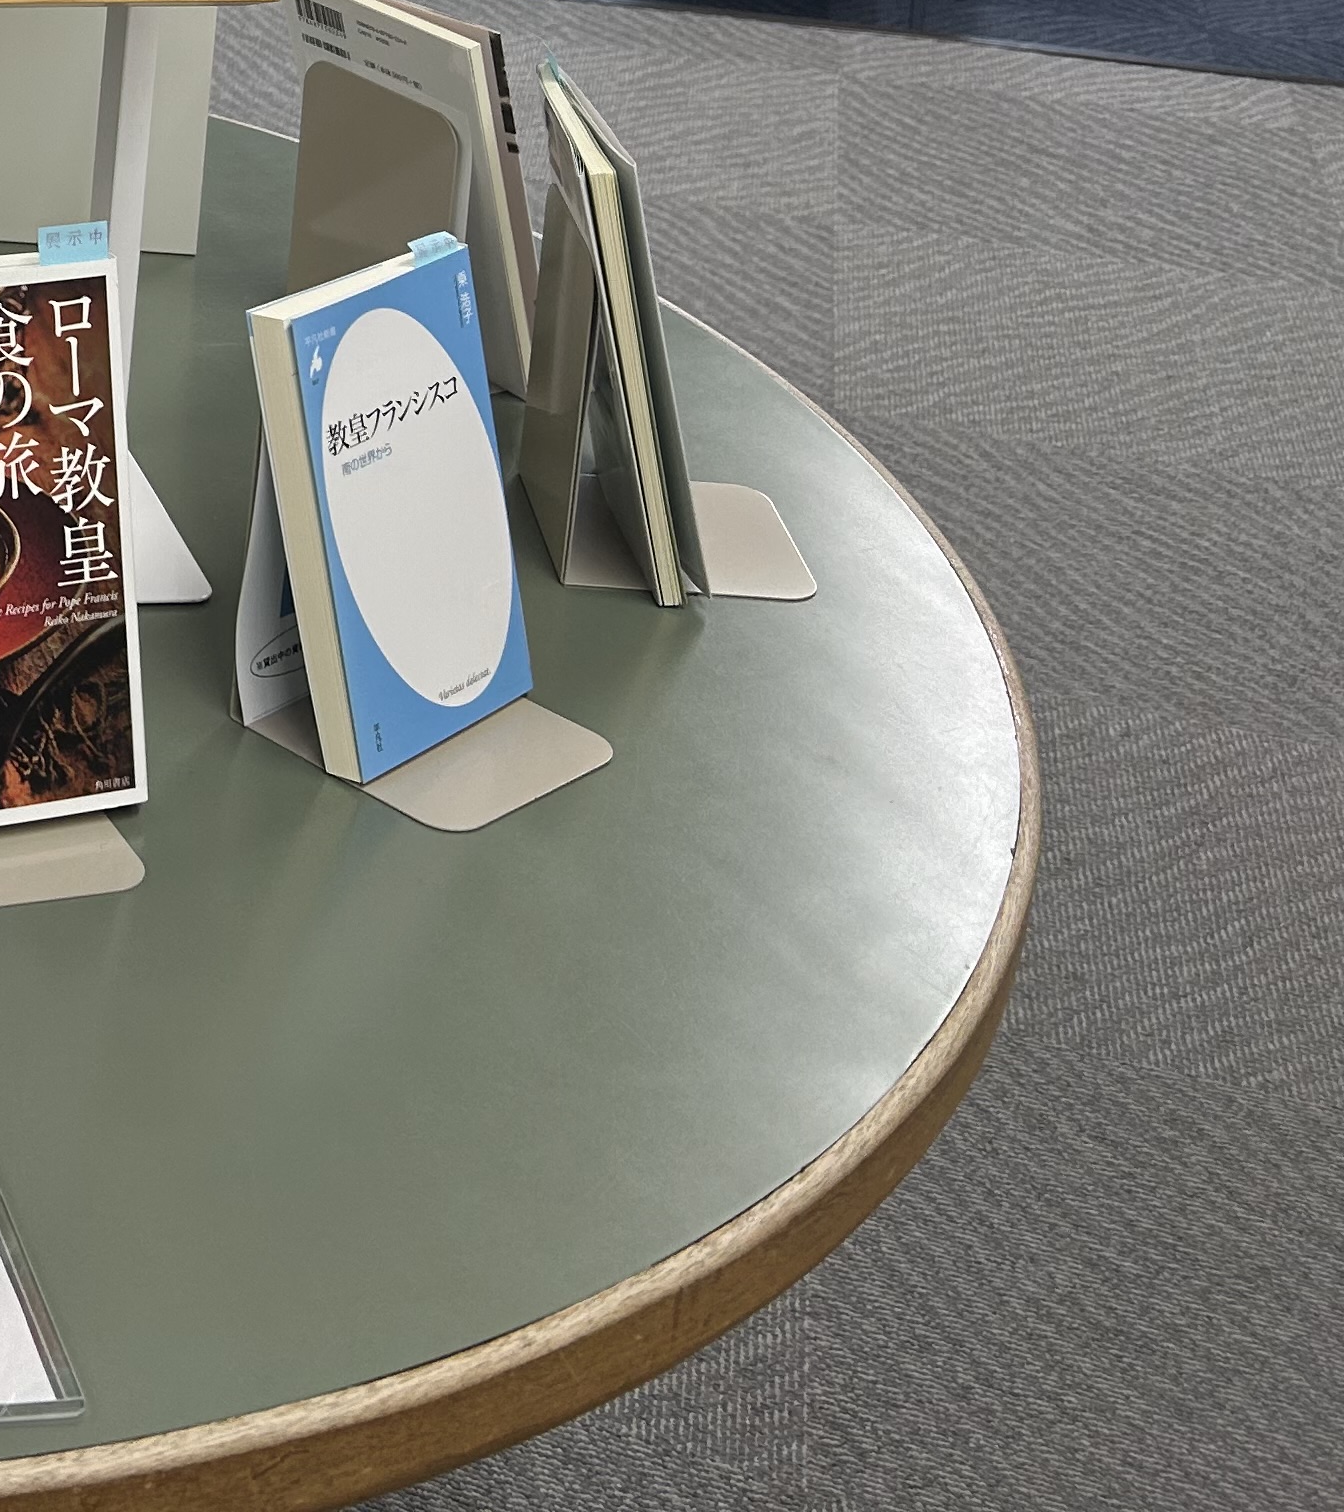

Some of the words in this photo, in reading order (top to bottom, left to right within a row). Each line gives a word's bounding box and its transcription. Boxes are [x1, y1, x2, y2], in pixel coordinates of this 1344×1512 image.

[48, 295, 119, 588] ローマ教皇
[327, 376, 458, 456] 教皇フランシスコ
[341, 443, 393, 476] 南の世界から
[5, 603, 40, 617] Recipes
[40, 598, 57, 614] for
[59, 596, 82, 611] Pope
[83, 589, 118, 605] Francis
